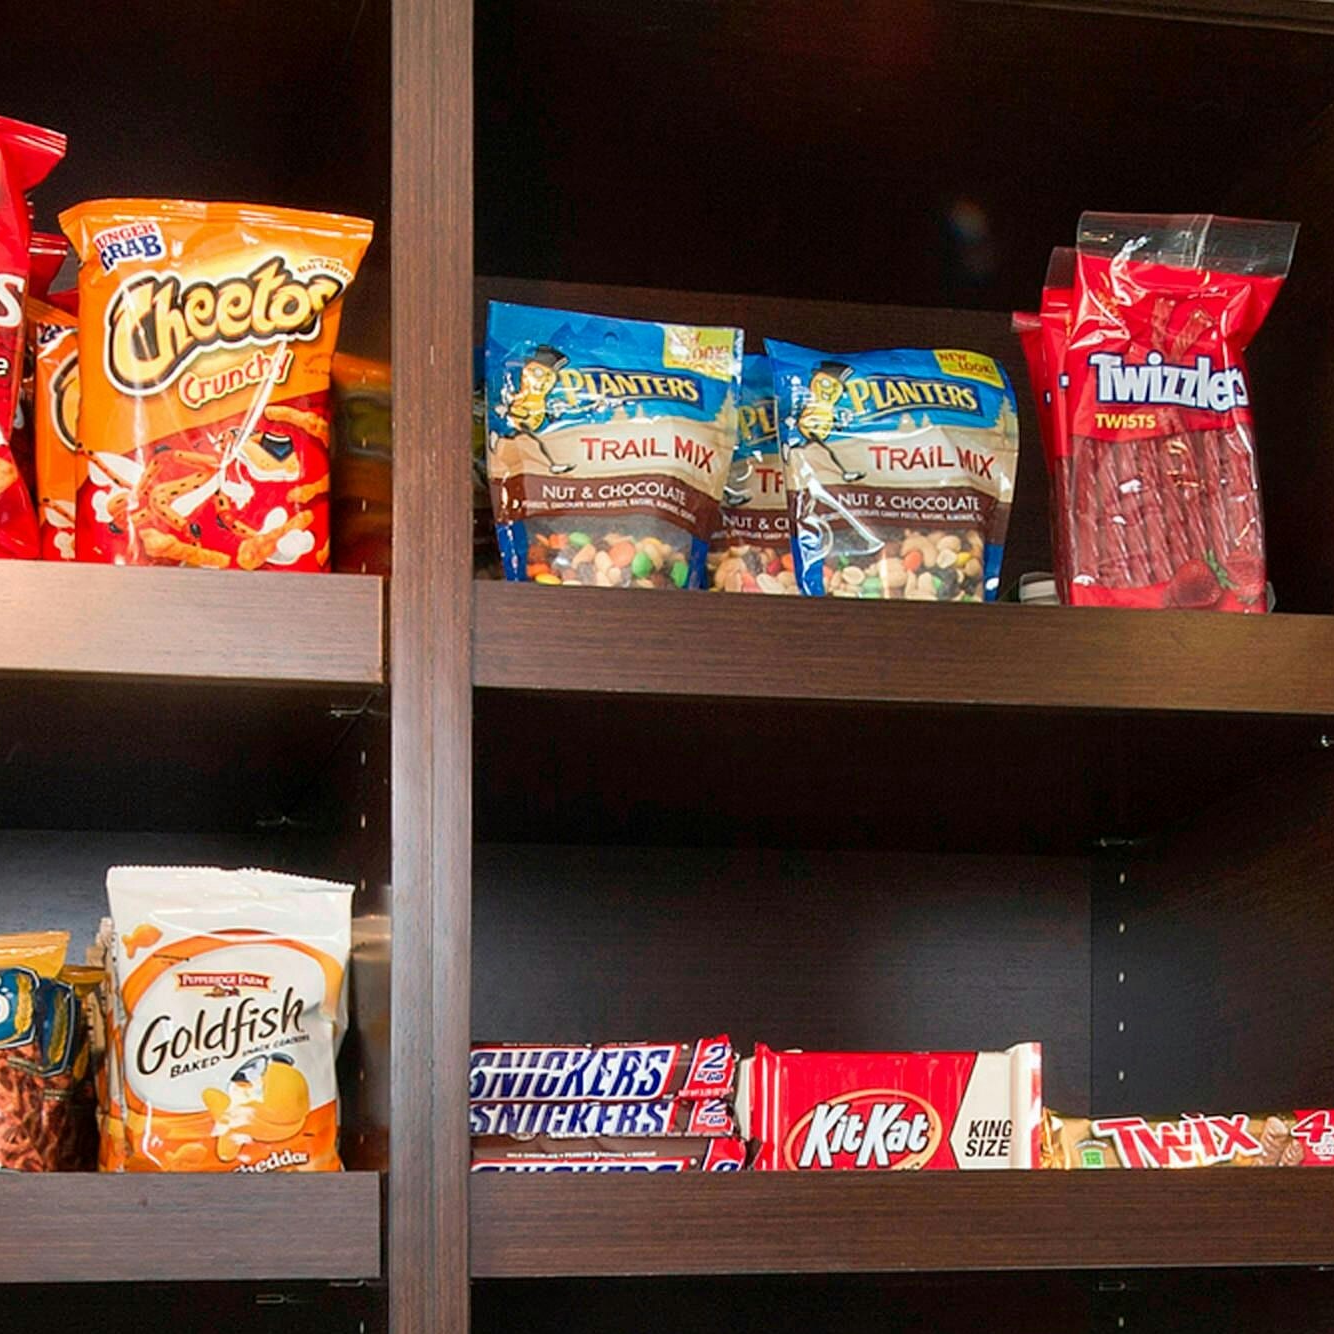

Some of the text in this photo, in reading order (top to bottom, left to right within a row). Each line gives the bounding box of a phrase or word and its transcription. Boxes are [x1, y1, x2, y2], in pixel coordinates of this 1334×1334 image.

[111, 257, 342, 390] Cheetos
[180, 350, 293, 405] Crunchy
[558, 367, 700, 408] PLANTERS
[846, 378, 980, 416] PLANTERS
[1095, 413, 1157, 429] TWISTS
[580, 436, 716, 474] TRAIL MIX
[542, 482, 687, 506] NUT & CHOCOLATE
[837, 492, 981, 512] NUT & CHOCOLATE
[182, 972, 265, 987] PEPPERIDGE FARM
[135, 986, 305, 1076] Goldfish
[169, 1056, 222, 1079] BAKED
[470, 1102, 668, 1134] SNICKERS
[968, 1119, 1013, 1138] KING
[964, 1140, 1010, 1158] SIZE
